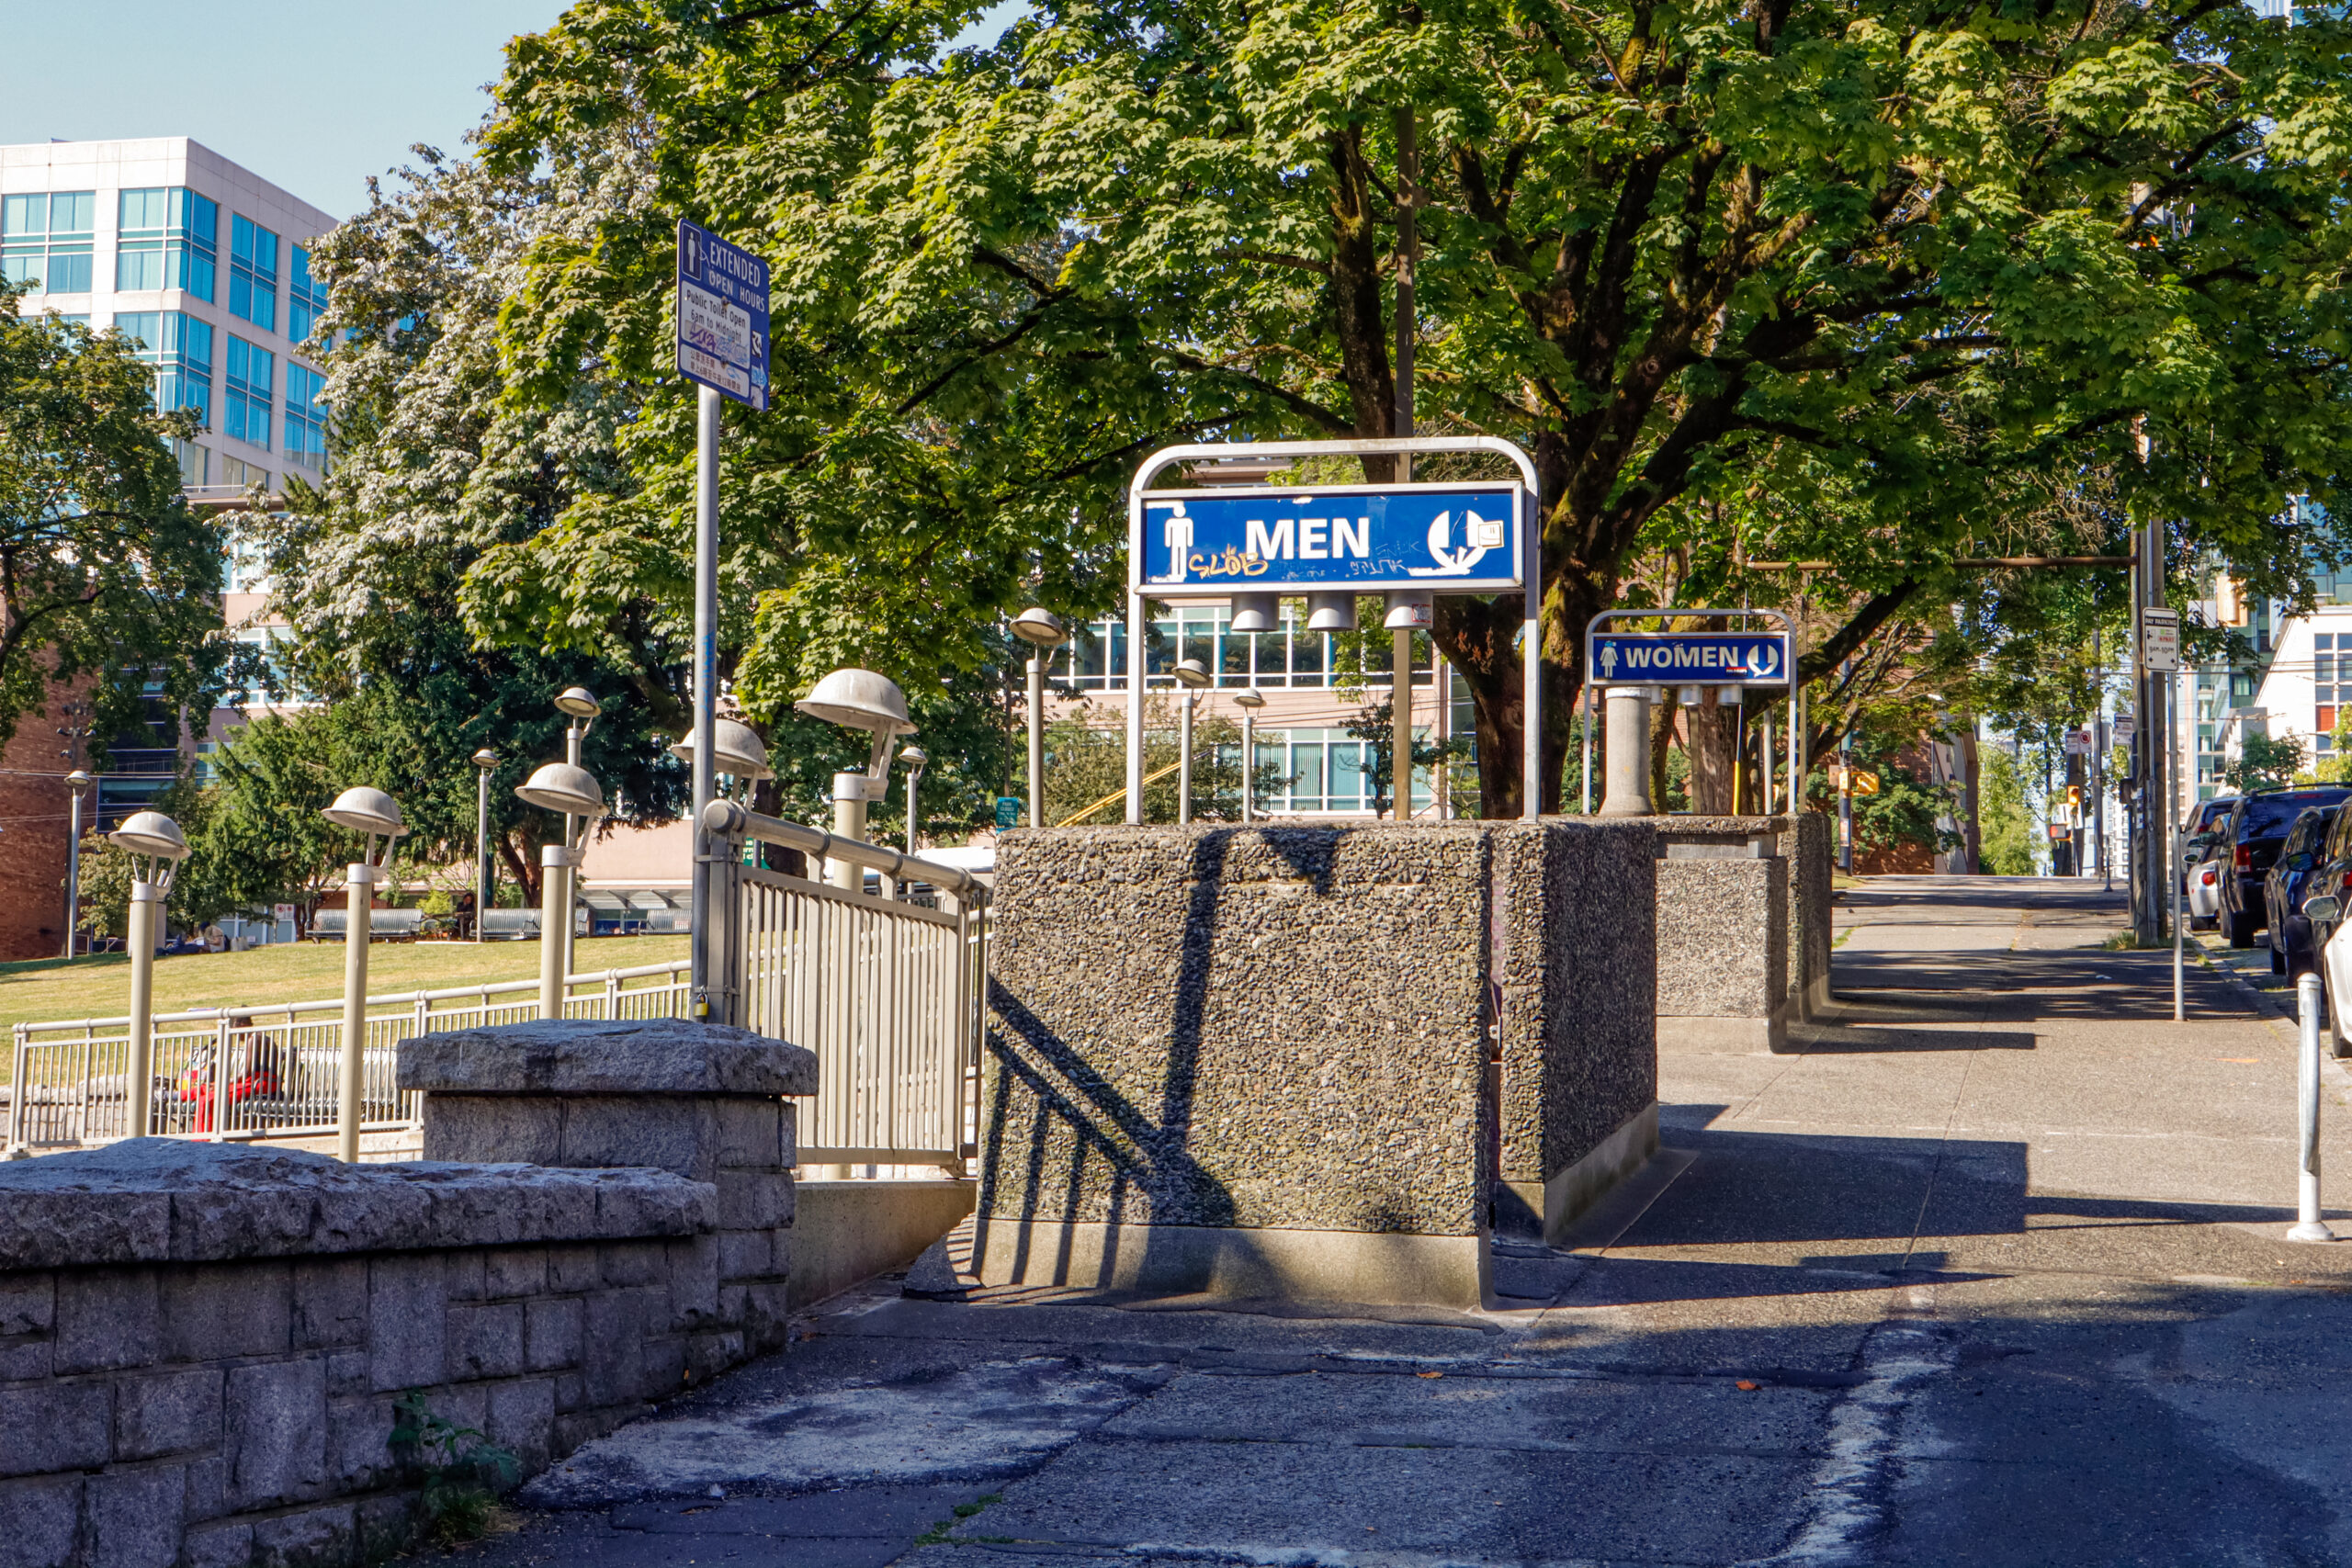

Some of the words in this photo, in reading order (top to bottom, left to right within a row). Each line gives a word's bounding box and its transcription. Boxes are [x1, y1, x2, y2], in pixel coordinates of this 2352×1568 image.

[710, 241, 761, 288] EXTENDED
[686, 288, 707, 310] Public
[709, 299, 728, 319] Toilet
[729, 310, 746, 329] Open
[708, 269, 733, 296] OPEN
[740, 288, 765, 312] HOURS
[691, 309, 705, 325] 6am
[707, 316, 714, 330] to
[715, 321, 742, 344] Midnight
[1245, 517, 1370, 560] MEN
[1624, 646, 1739, 668] WOMEN
